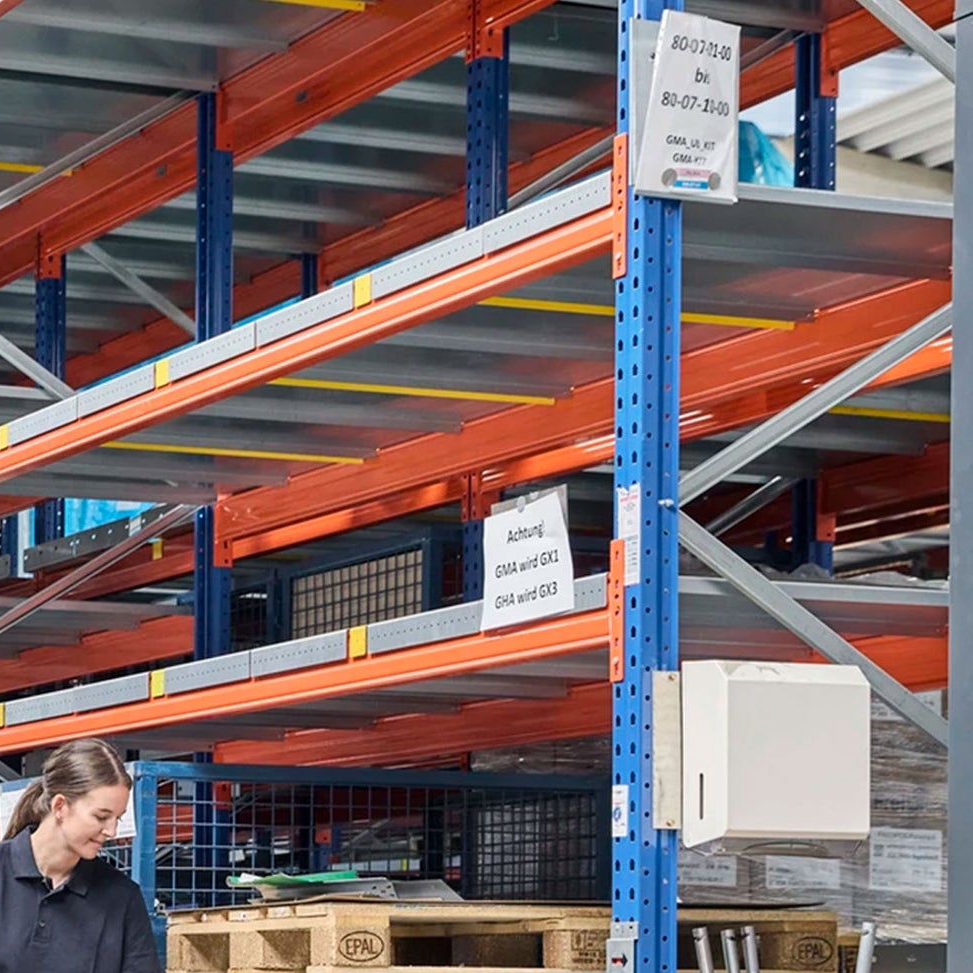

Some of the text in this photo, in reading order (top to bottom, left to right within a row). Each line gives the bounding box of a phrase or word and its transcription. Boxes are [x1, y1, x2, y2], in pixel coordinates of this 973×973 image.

[660, 91, 730, 117] 80-07-10-00
[495, 549, 559, 578] GMA wird GX1
[494, 581, 558, 609] GHA wird GX3
[345, 938, 377, 956] EPAL
[798, 943, 826, 959] EPAL
